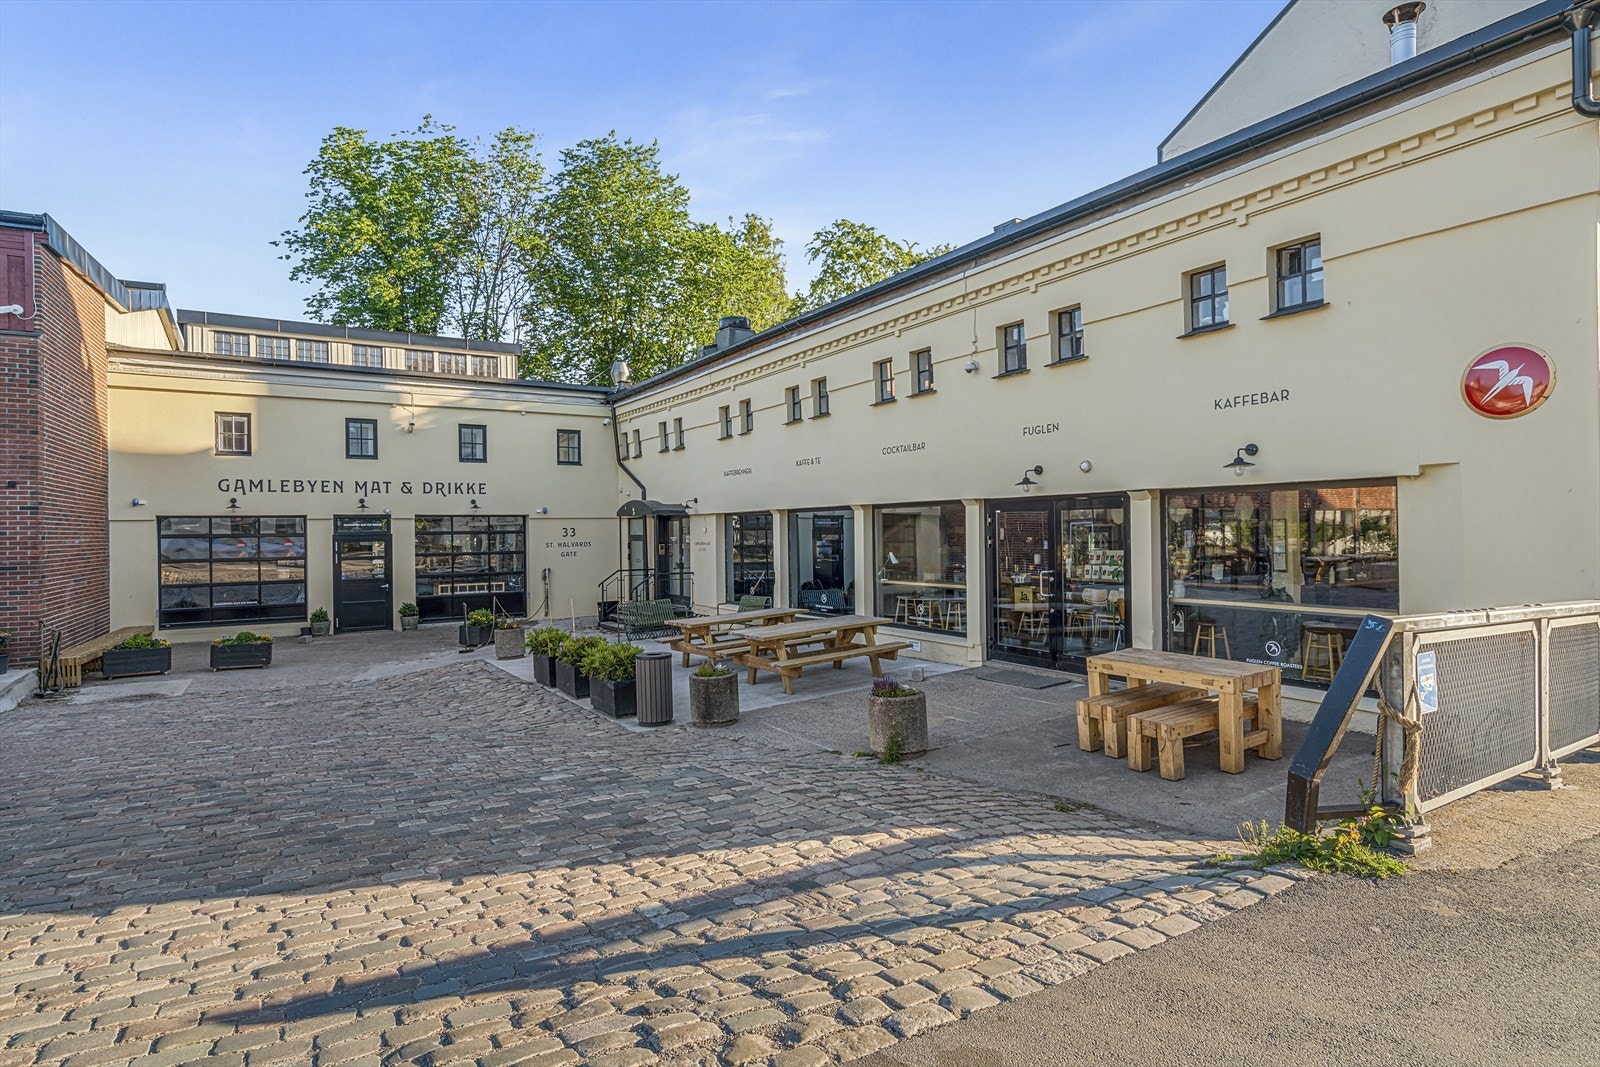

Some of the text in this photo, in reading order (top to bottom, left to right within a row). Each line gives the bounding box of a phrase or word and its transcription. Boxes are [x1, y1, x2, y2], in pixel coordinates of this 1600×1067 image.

[1214, 389, 1290, 411] KAFFEBAR
[1022, 422, 1059, 437] FUGLEN
[881, 441, 926, 456] COCKTAILBAR
[795, 458, 810, 467] KAFFE
[815, 456, 821, 465] TE
[217, 478, 487, 498] GAMLEBYEN MAT & DRIKKE
[562, 527, 576, 538] 33
[1245, 657, 1304, 670] FUGLEN COFFEE ROASTERS
